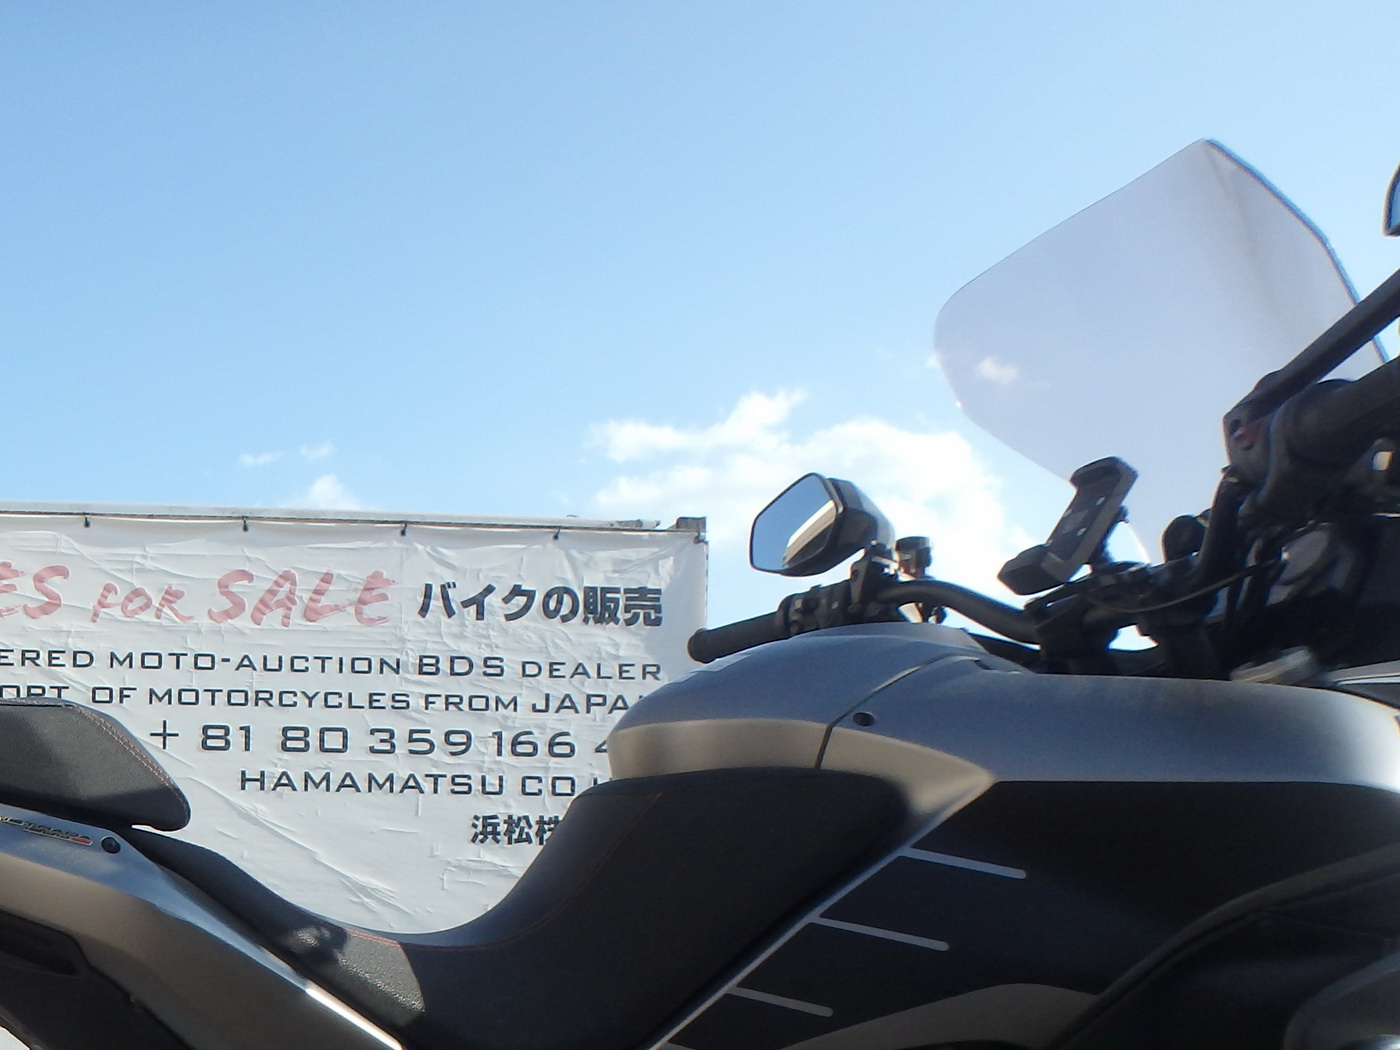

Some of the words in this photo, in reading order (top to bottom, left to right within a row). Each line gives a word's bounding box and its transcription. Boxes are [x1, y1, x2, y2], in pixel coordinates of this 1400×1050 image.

[92, 582, 194, 622] FOR
[208, 569, 398, 627] SALE
[418, 581, 663, 627] バイクの販売
[110, 652, 401, 675] MOTO-AUCTION
[417, 655, 505, 678] BDS
[521, 660, 662, 681] DEALER
[91, 686, 137, 704] OF
[149, 688, 411, 710] MOTORCYCLES
[424, 693, 518, 713] FROM
[531, 692, 643, 716] JAPA
[200, 724, 251, 752] 81
[280, 726, 349, 754] 80
[240, 770, 504, 796] HAMAMATSU
[520, 776, 576, 797] CO
